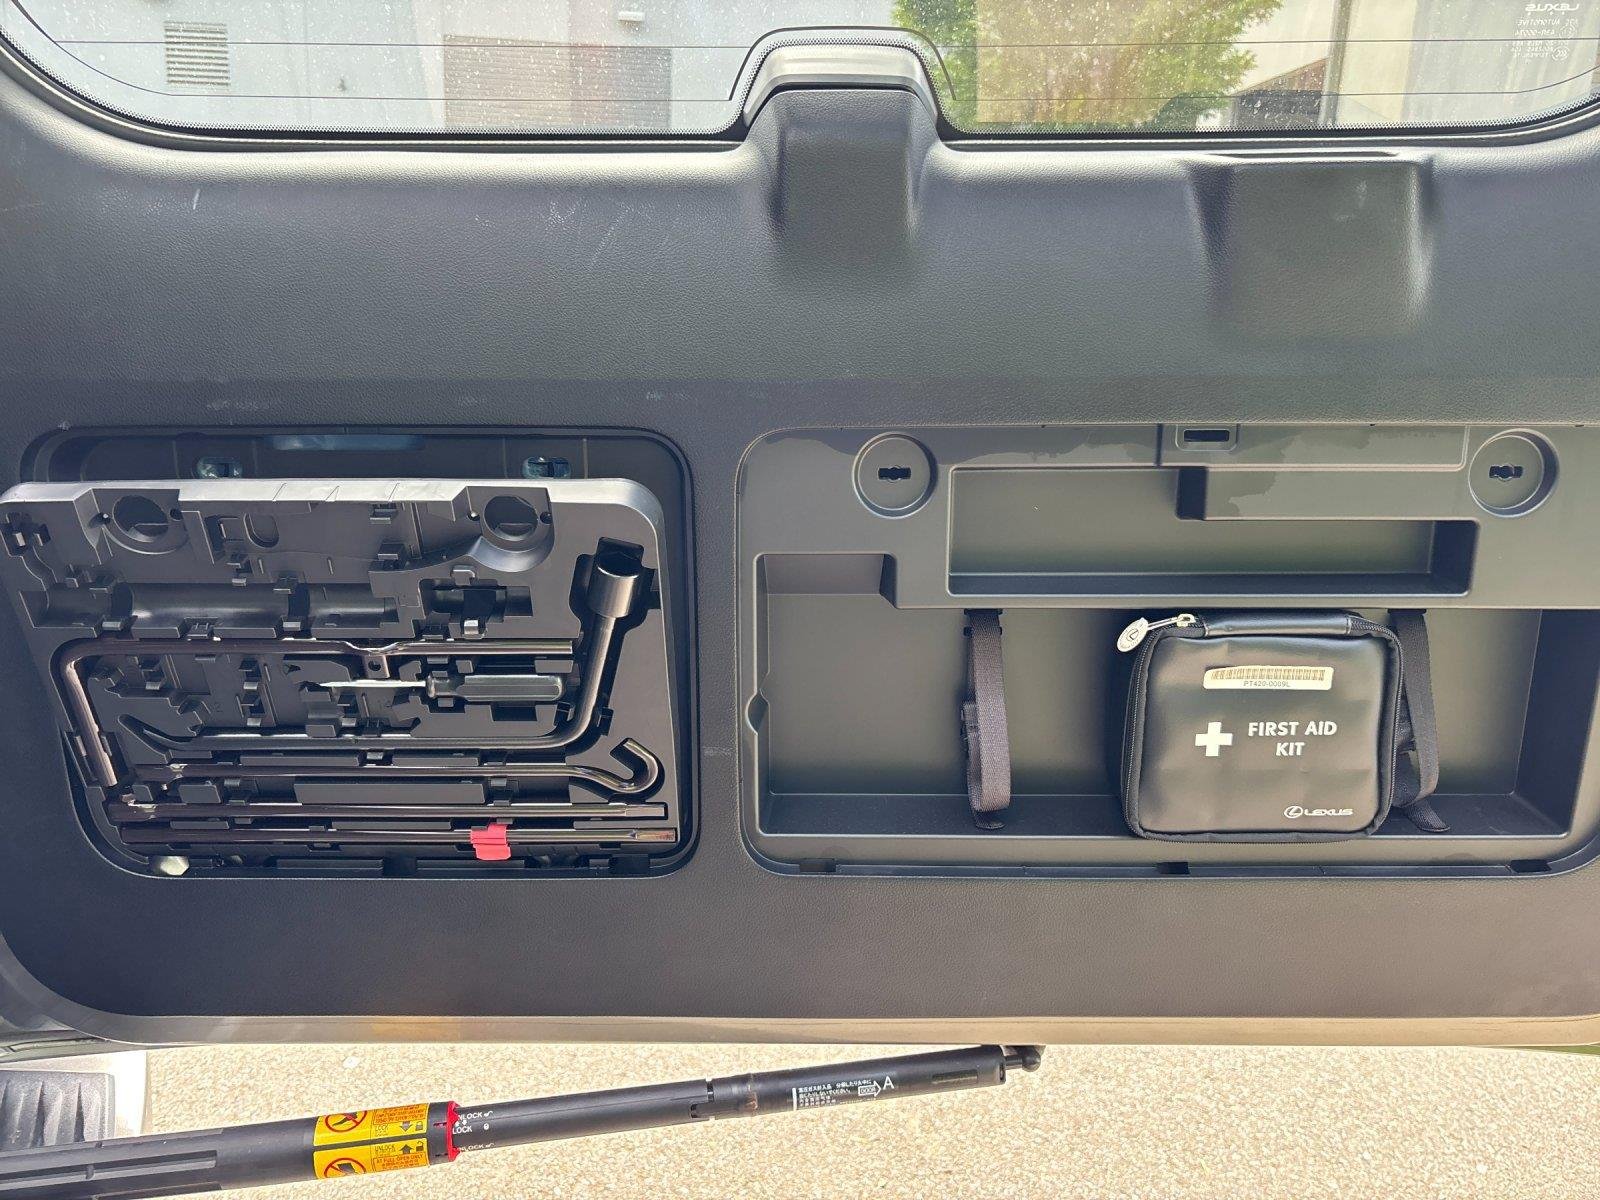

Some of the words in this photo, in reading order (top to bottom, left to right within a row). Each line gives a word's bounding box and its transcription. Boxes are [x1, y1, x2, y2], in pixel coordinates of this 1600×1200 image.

[1248, 721, 1299, 737] FIRST
[1304, 720, 1338, 736] AID
[1275, 742, 1305, 756] KIT
[1304, 808, 1354, 817] LEXUS
[883, 1076, 895, 1090] A
[458, 1111, 483, 1121] NLOCK
[452, 1125, 473, 1134] LOCK
